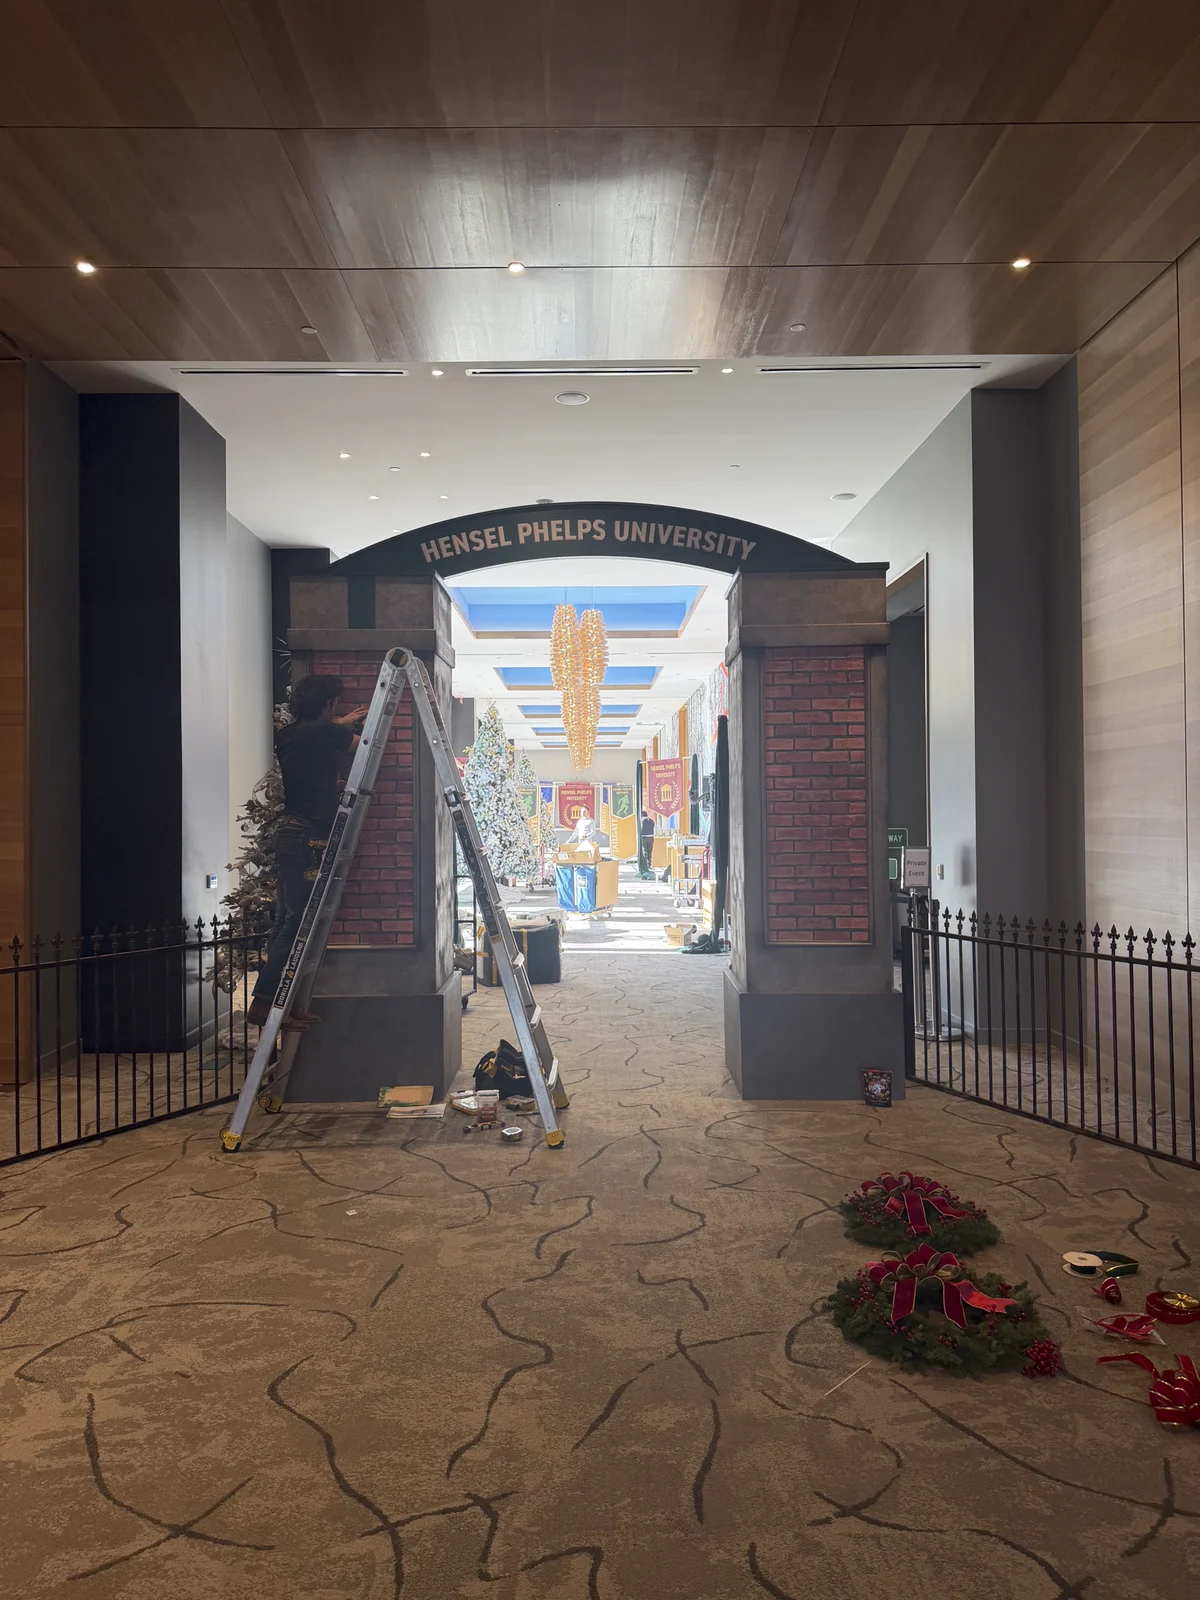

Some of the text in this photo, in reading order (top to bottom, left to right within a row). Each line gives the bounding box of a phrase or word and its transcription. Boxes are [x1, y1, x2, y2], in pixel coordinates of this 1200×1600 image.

[420, 519, 757, 564] HENSEL PHELPS UNIVERSITY
[611, 817, 619, 854] TAILGATE
[277, 942, 304, 1005] GORILLA LADDERS
